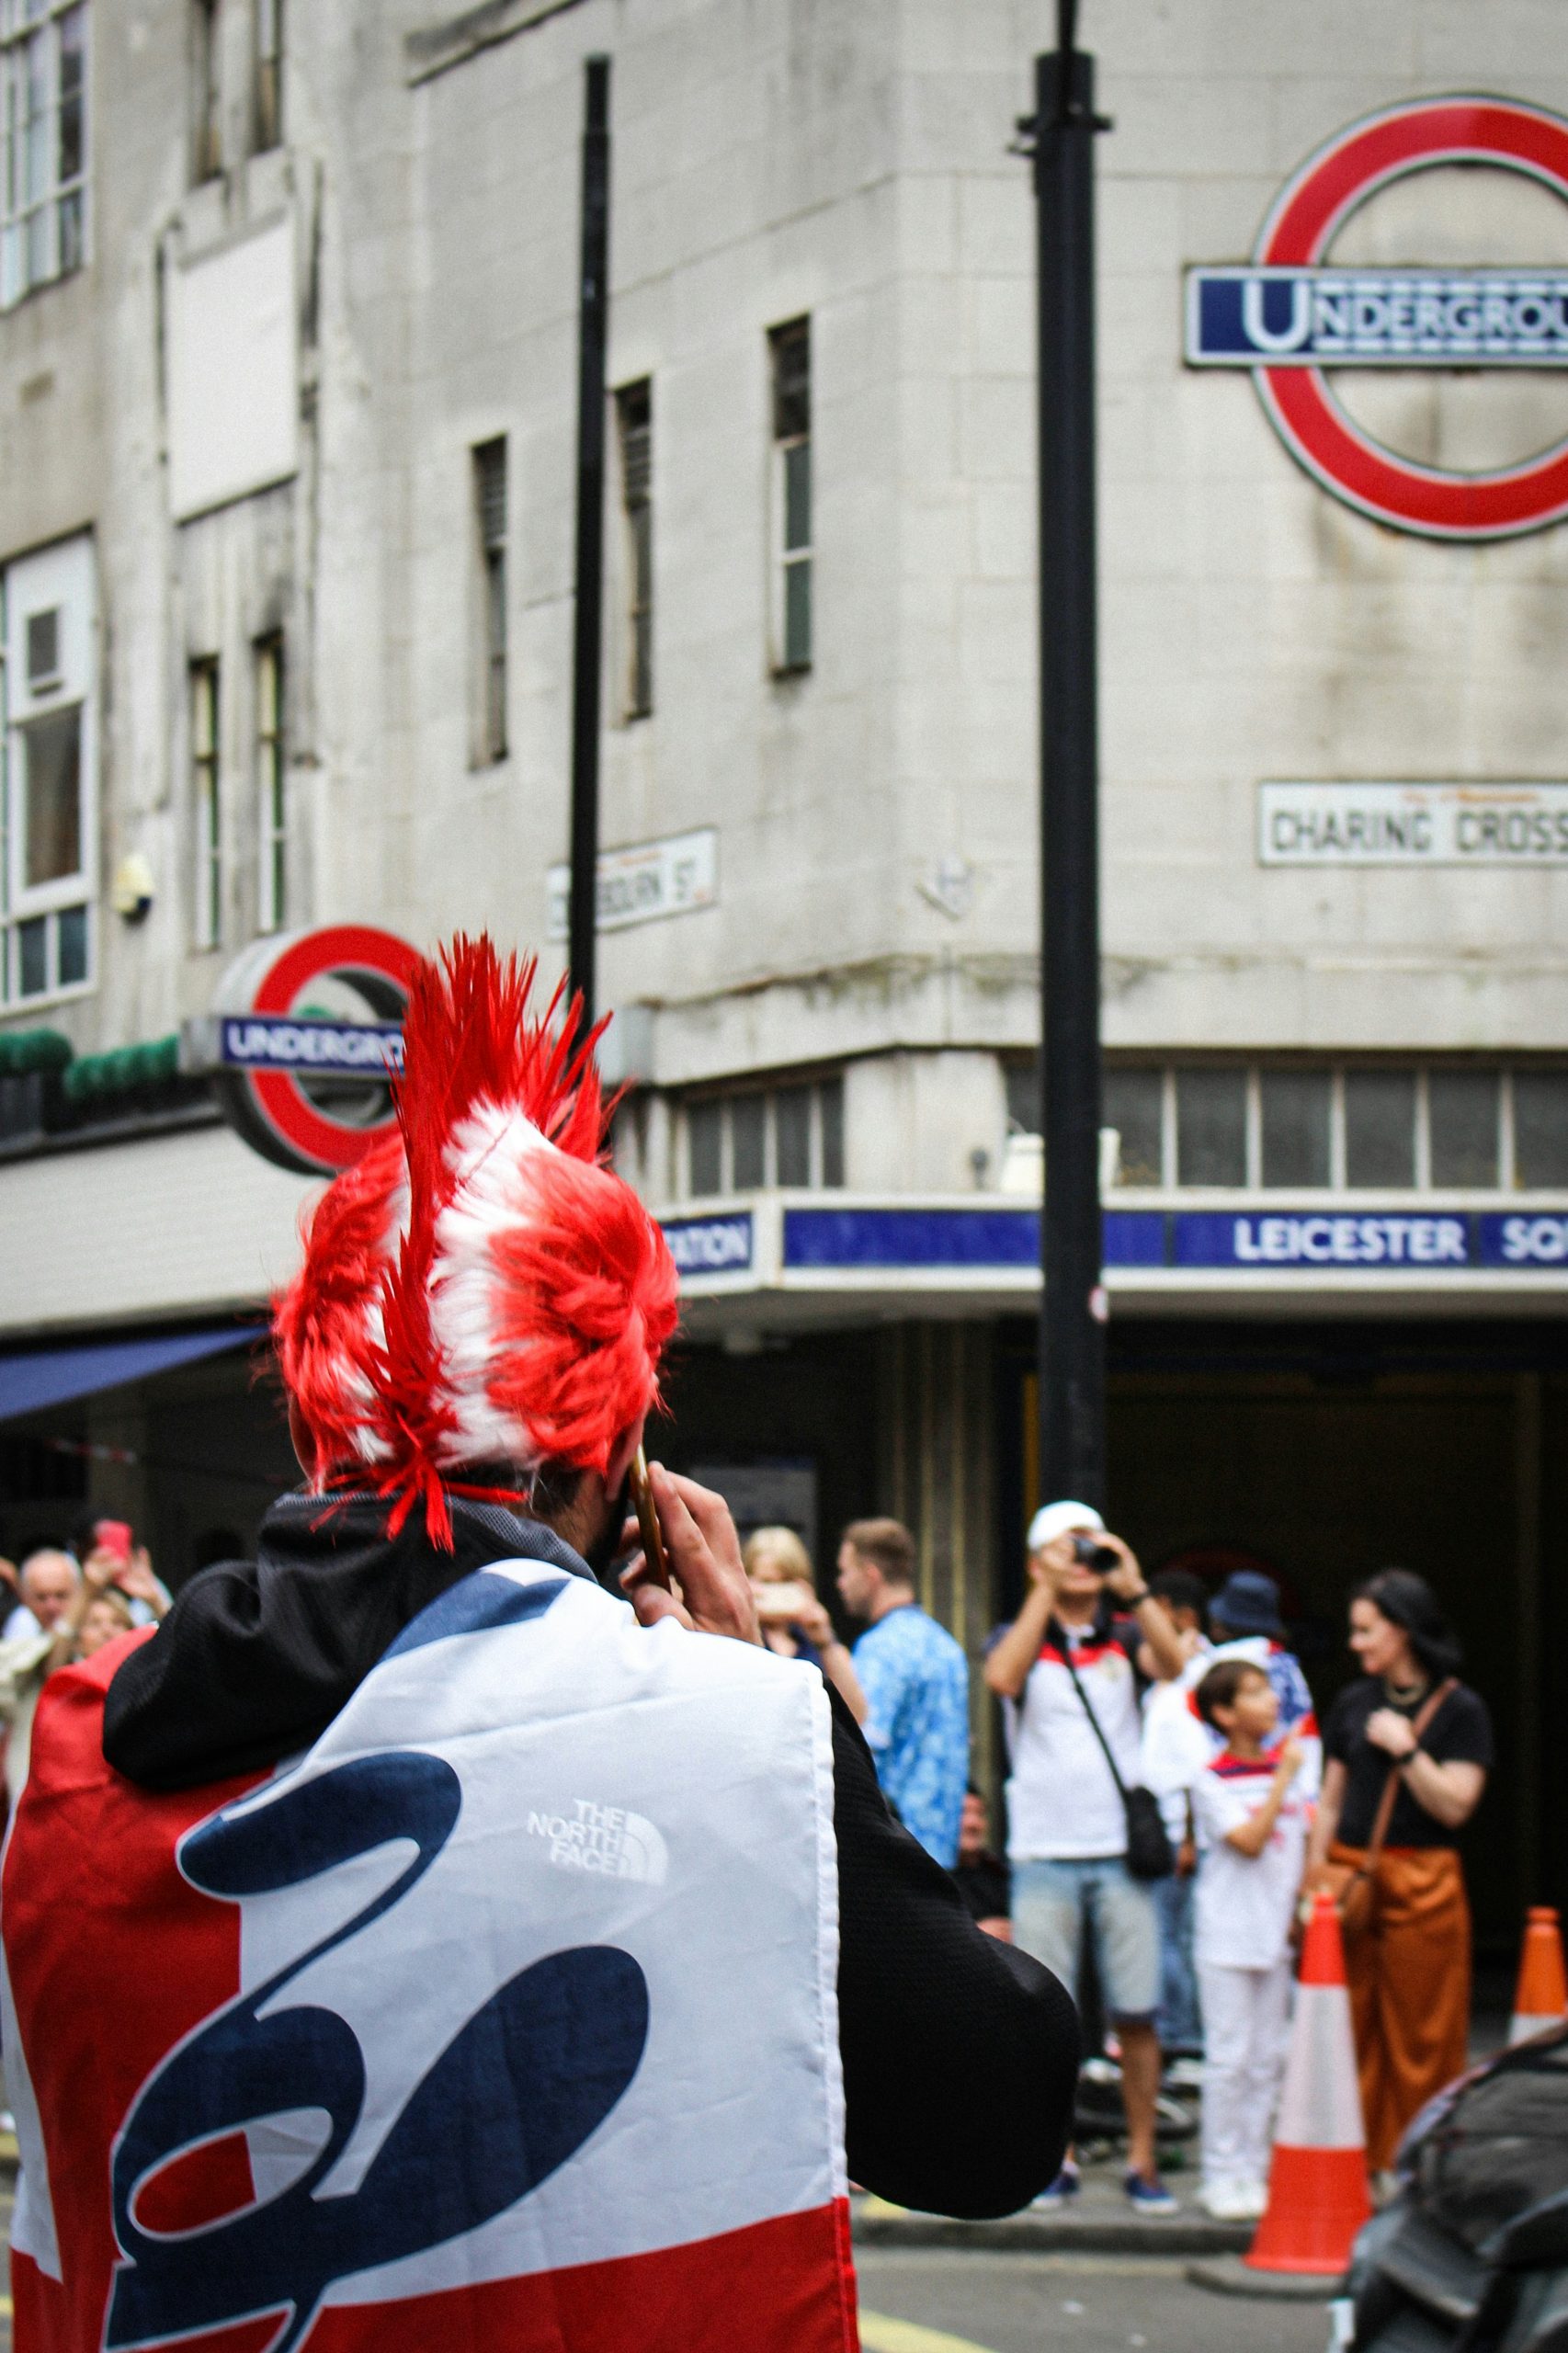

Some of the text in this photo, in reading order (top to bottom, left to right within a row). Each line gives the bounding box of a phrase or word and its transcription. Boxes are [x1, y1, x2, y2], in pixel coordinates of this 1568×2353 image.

[1272, 809, 1568, 853] CHARING CROSS
[227, 1024, 405, 1068] UNDERGRO
[664, 1222, 749, 1267] ATION
[1233, 1217, 1568, 1262] LEICESTER SQ
[527, 1811, 622, 1855] NORTH
[573, 1798, 626, 1832] THE
[551, 1837, 621, 1876] FACE
